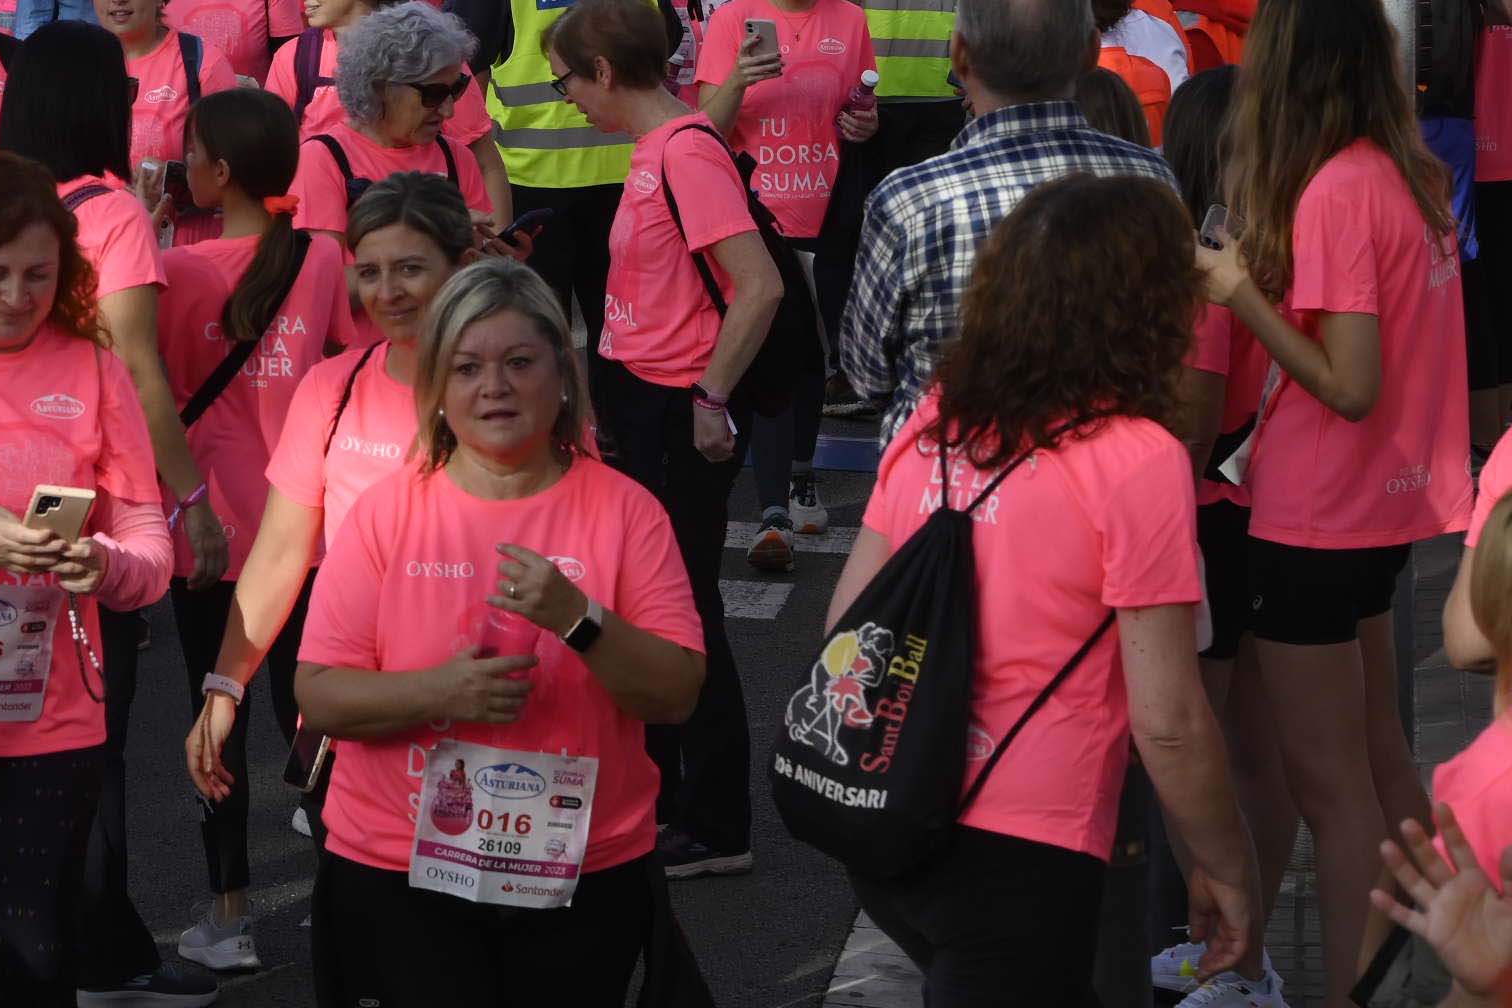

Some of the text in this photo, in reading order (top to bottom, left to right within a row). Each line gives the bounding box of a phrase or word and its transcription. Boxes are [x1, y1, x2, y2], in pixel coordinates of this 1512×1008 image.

[759, 118, 786, 137] TU
[759, 143, 839, 165] DORSA
[761, 171, 829, 191] SUMA
[243, 356, 294, 377] UJER
[407, 560, 475, 580] OYSHO
[479, 772, 540, 792] ASTURIANA
[552, 775, 584, 787] SUMA
[794, 763, 888, 810] ANIVERSARI
[477, 808, 532, 835] 016
[478, 838, 521, 855] 26109
[435, 847, 478, 865] CARRERA
[479, 859, 491, 868] DE
[493, 861, 506, 870] LA
[508, 863, 541, 873] MUJER
[426, 866, 475, 889] OYSHO
